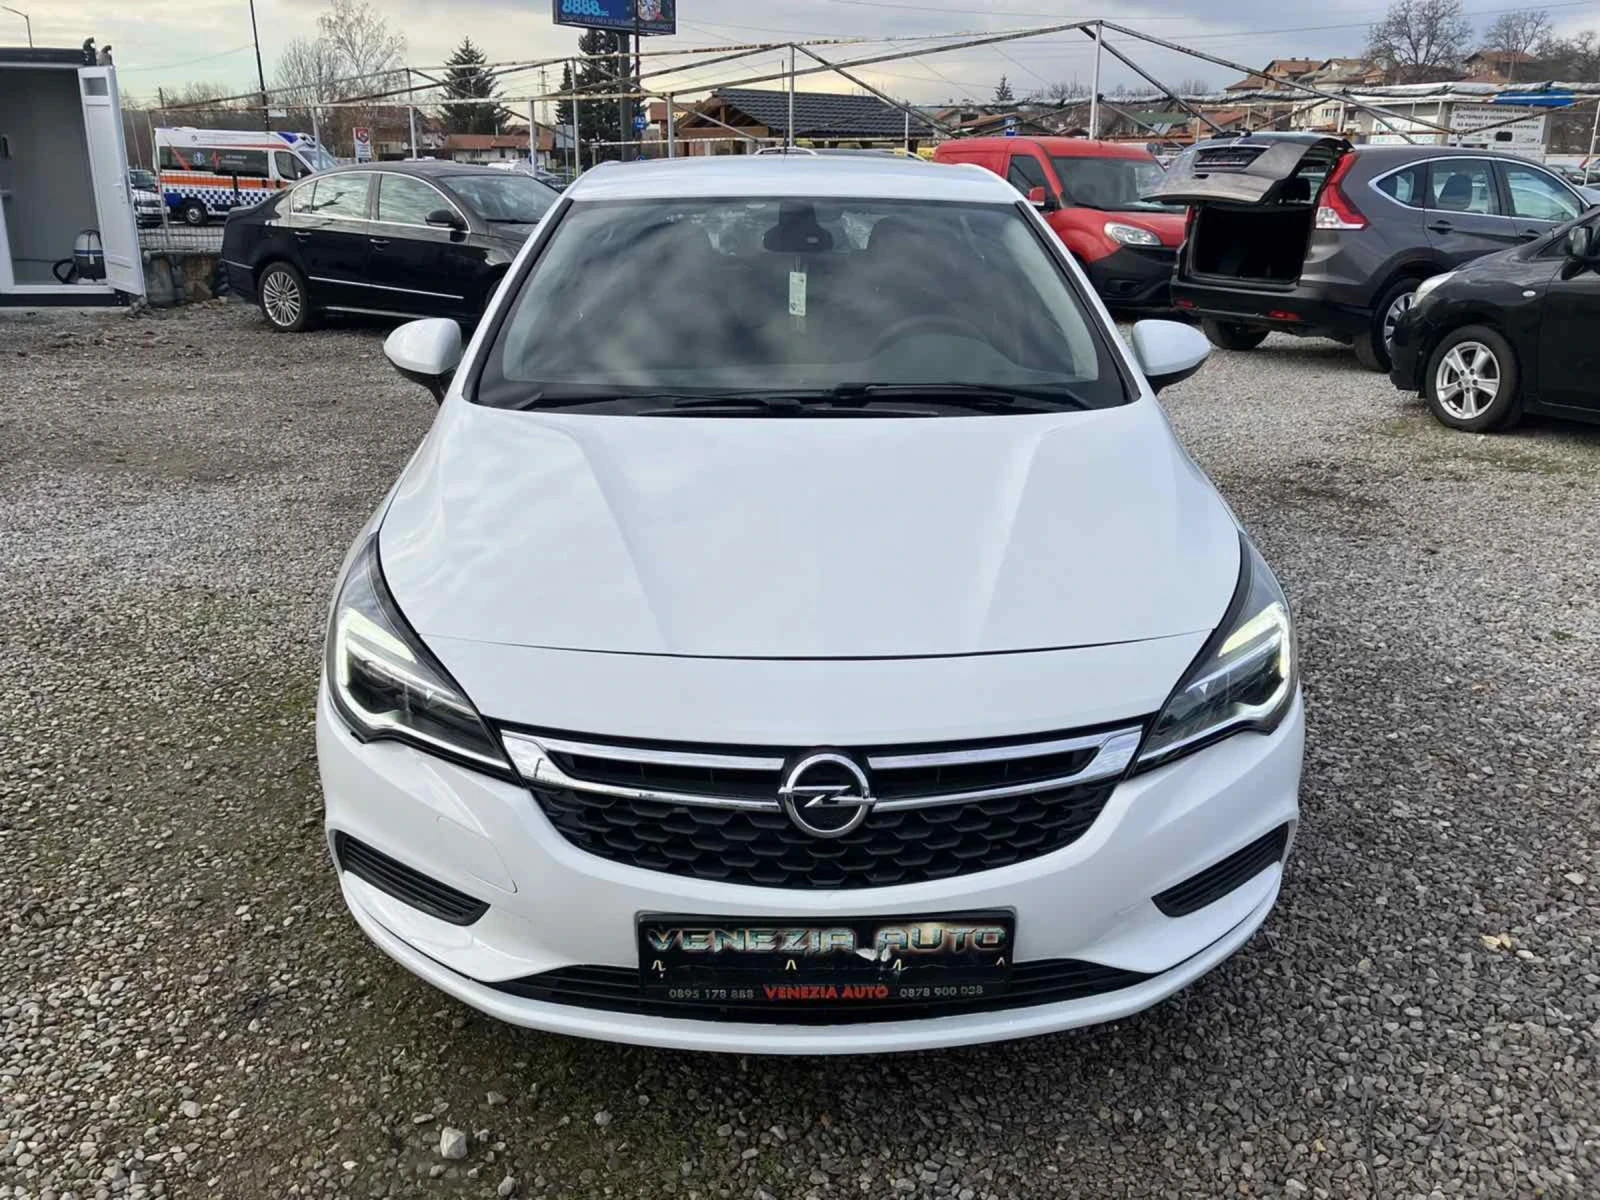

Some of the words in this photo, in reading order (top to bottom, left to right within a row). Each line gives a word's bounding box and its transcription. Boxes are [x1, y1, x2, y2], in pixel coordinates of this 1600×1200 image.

[648, 927, 856, 954] VENEZIA
[878, 926, 1007, 952] AUTO
[668, 988, 700, 999] 0895
[705, 989, 727, 999] 178
[763, 984, 838, 999] VENEZIA
[841, 984, 889, 999] AUTO
[900, 987, 930, 998] 0878
[933, 986, 957, 997] 900
